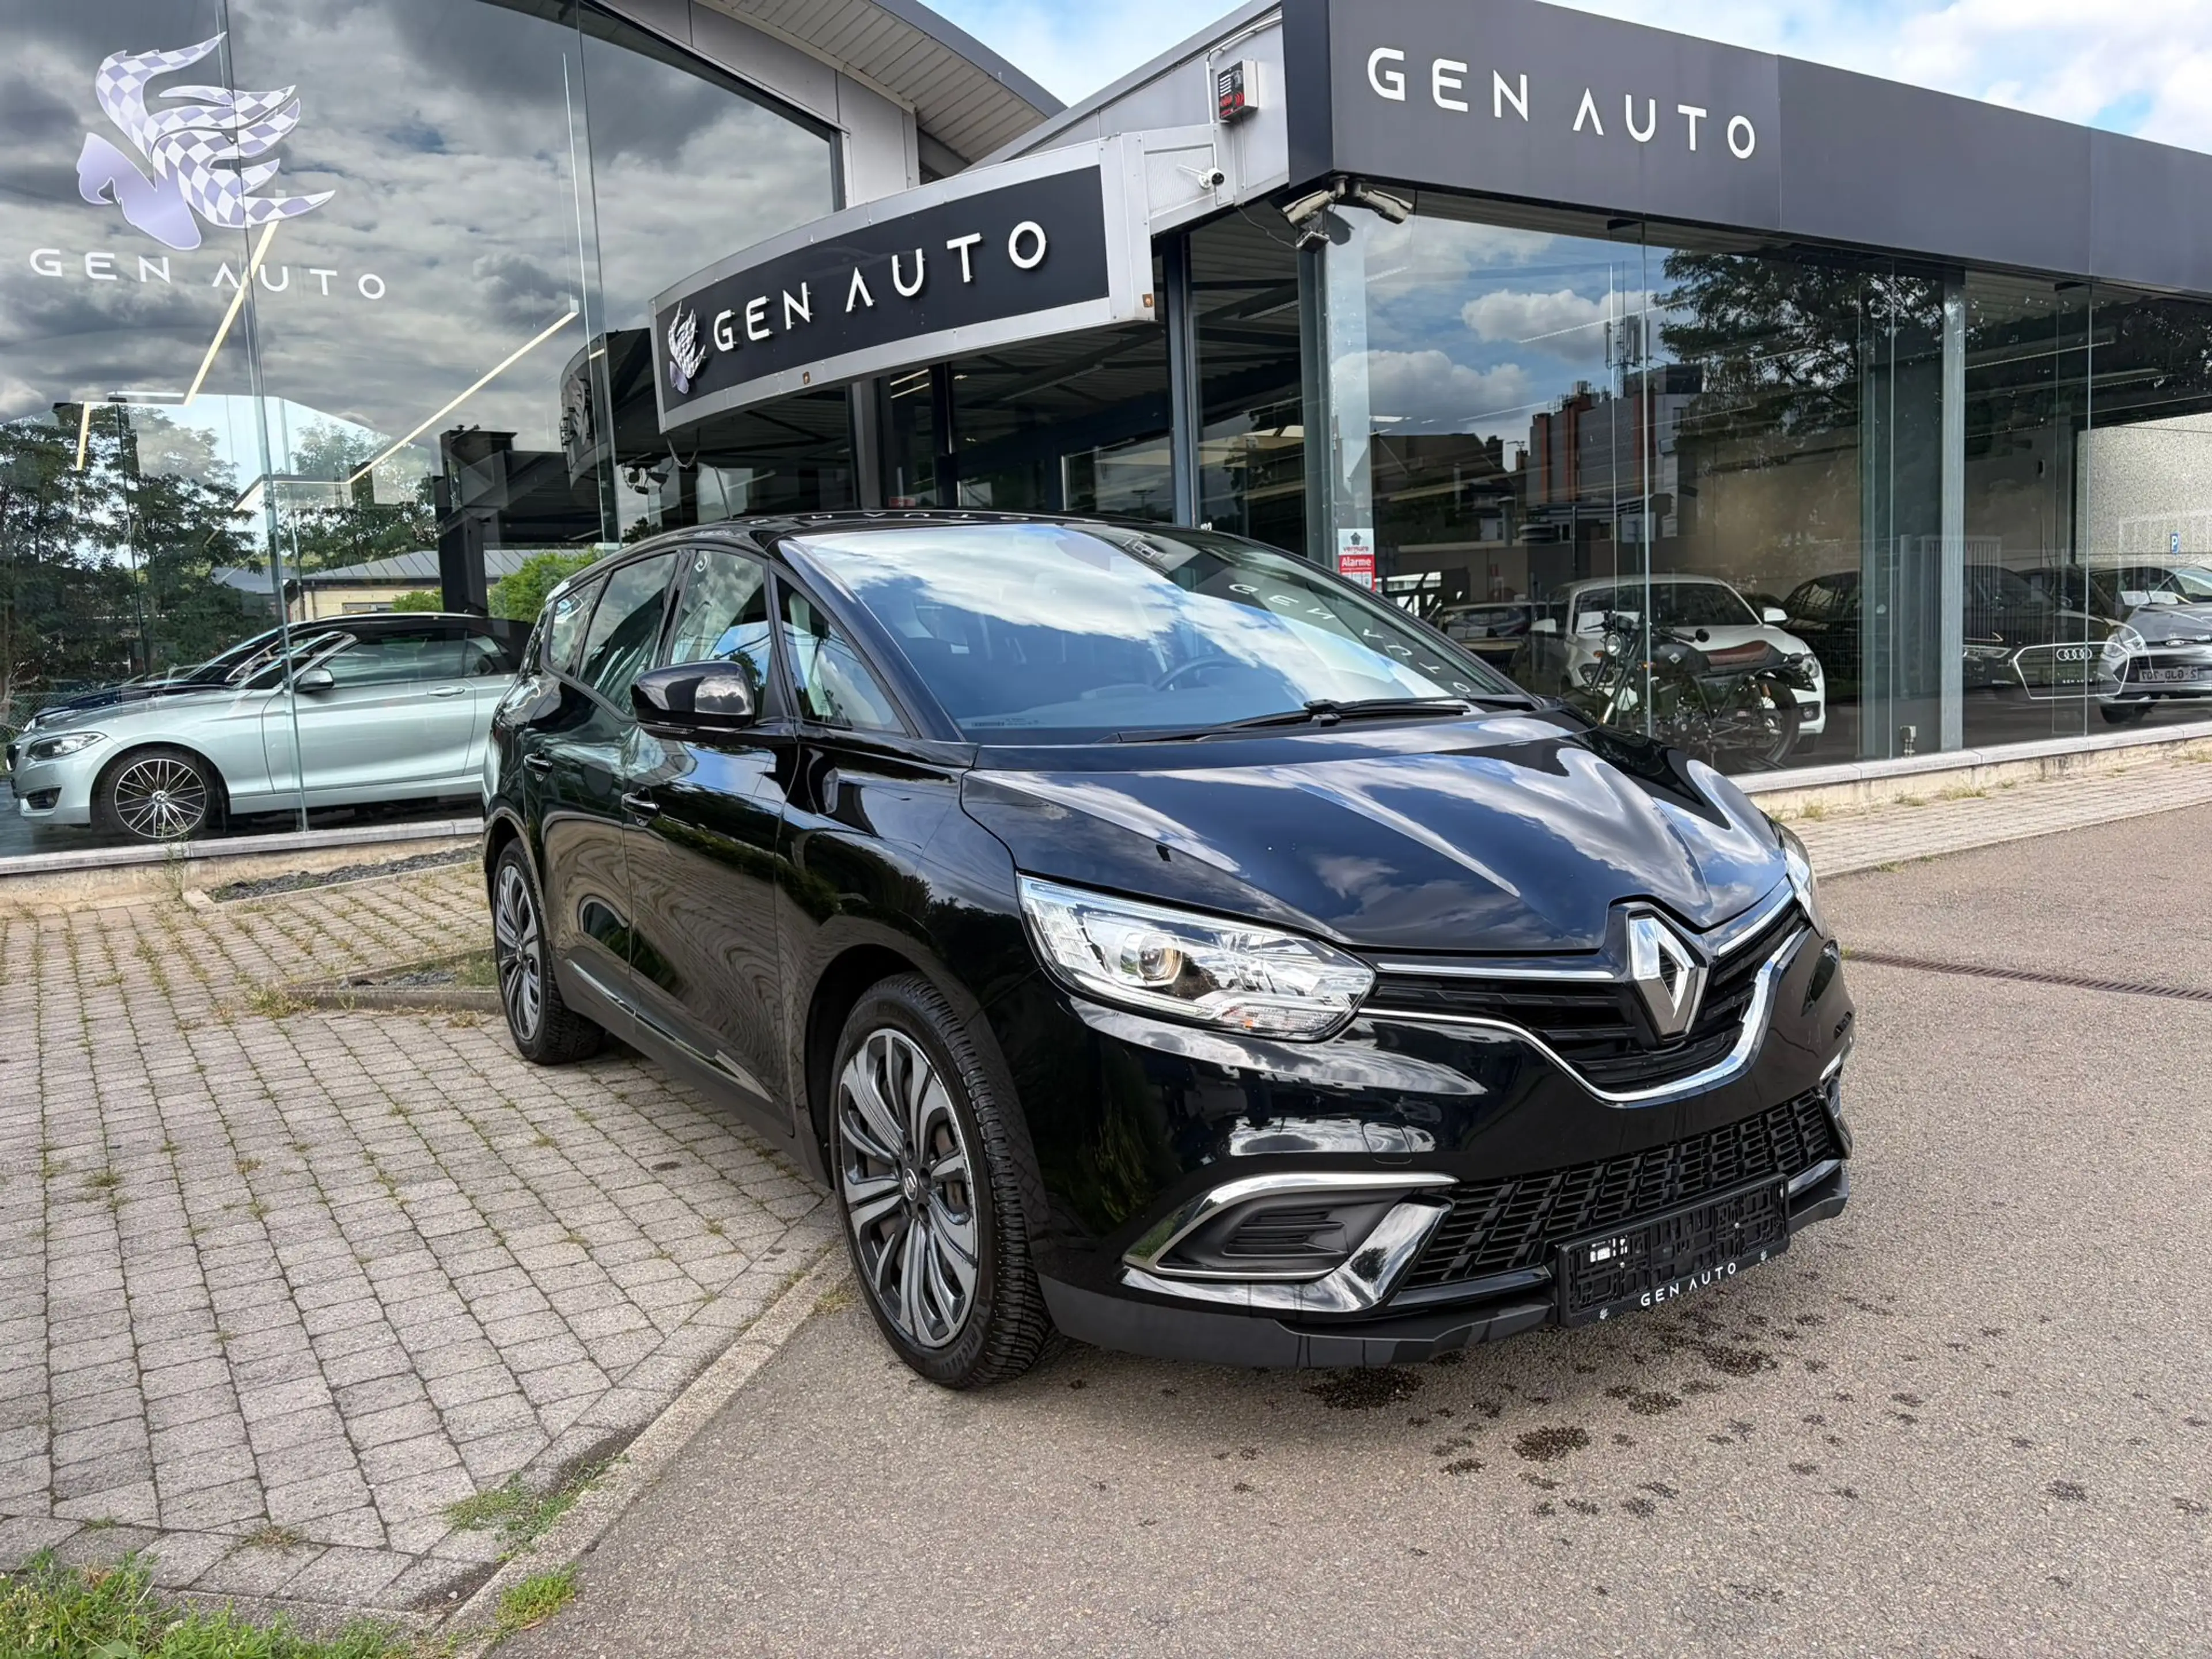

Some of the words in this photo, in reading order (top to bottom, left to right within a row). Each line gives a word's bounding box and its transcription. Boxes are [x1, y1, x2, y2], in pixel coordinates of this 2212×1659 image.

[1367, 47, 1529, 122] GEN
[1573, 88, 1756, 159] AUTO
[29, 248, 171, 285] GEN
[212, 262, 386, 300] AUTO
[714, 282, 811, 352] GEN
[845, 221, 1047, 313] AUTO
[1341, 556, 1372, 567] Alarme
[2171, 536, 2178, 550] P
[1641, 1282, 1680, 1307] GEN
[1689, 1262, 1736, 1291] AUTO
